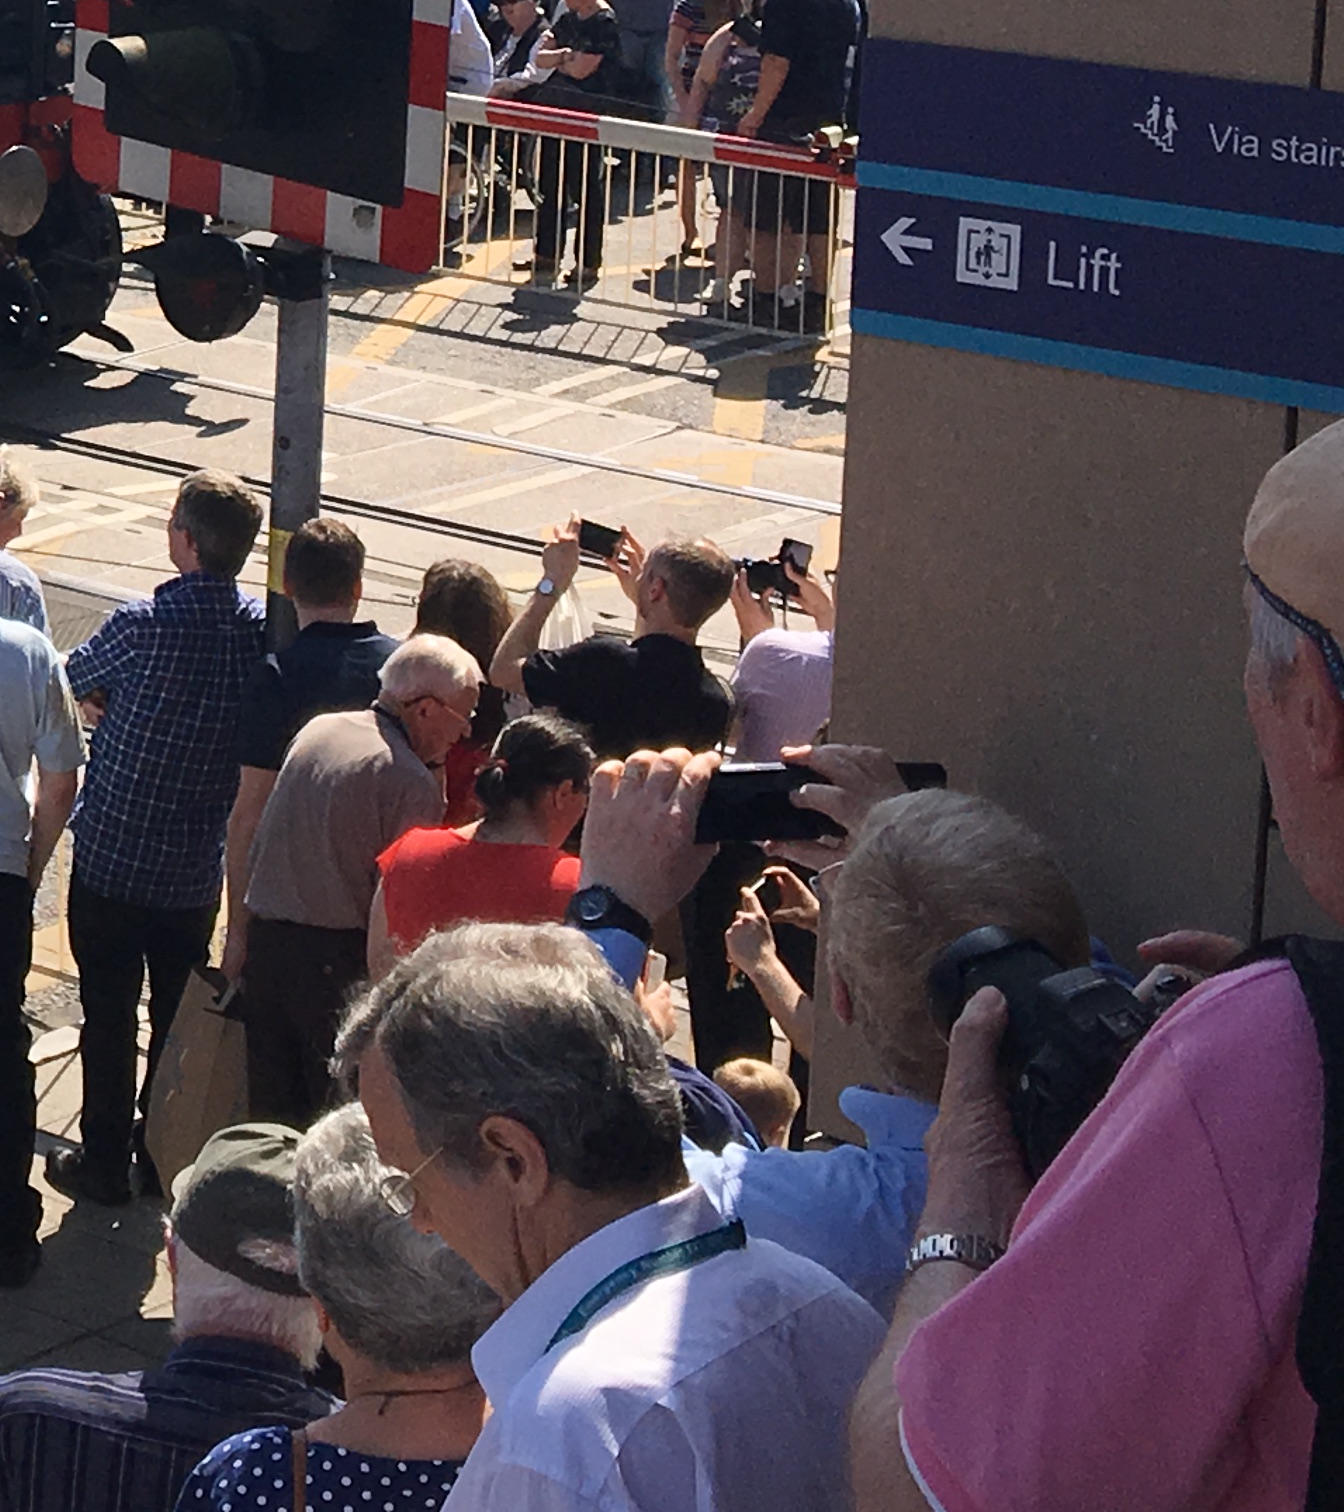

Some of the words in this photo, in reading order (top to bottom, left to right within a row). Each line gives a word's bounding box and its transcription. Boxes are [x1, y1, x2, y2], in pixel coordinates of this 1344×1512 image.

[1208, 122, 1260, 159] Via
[1271, 135, 1344, 167] stair
[1047, 240, 1122, 296] Lift
